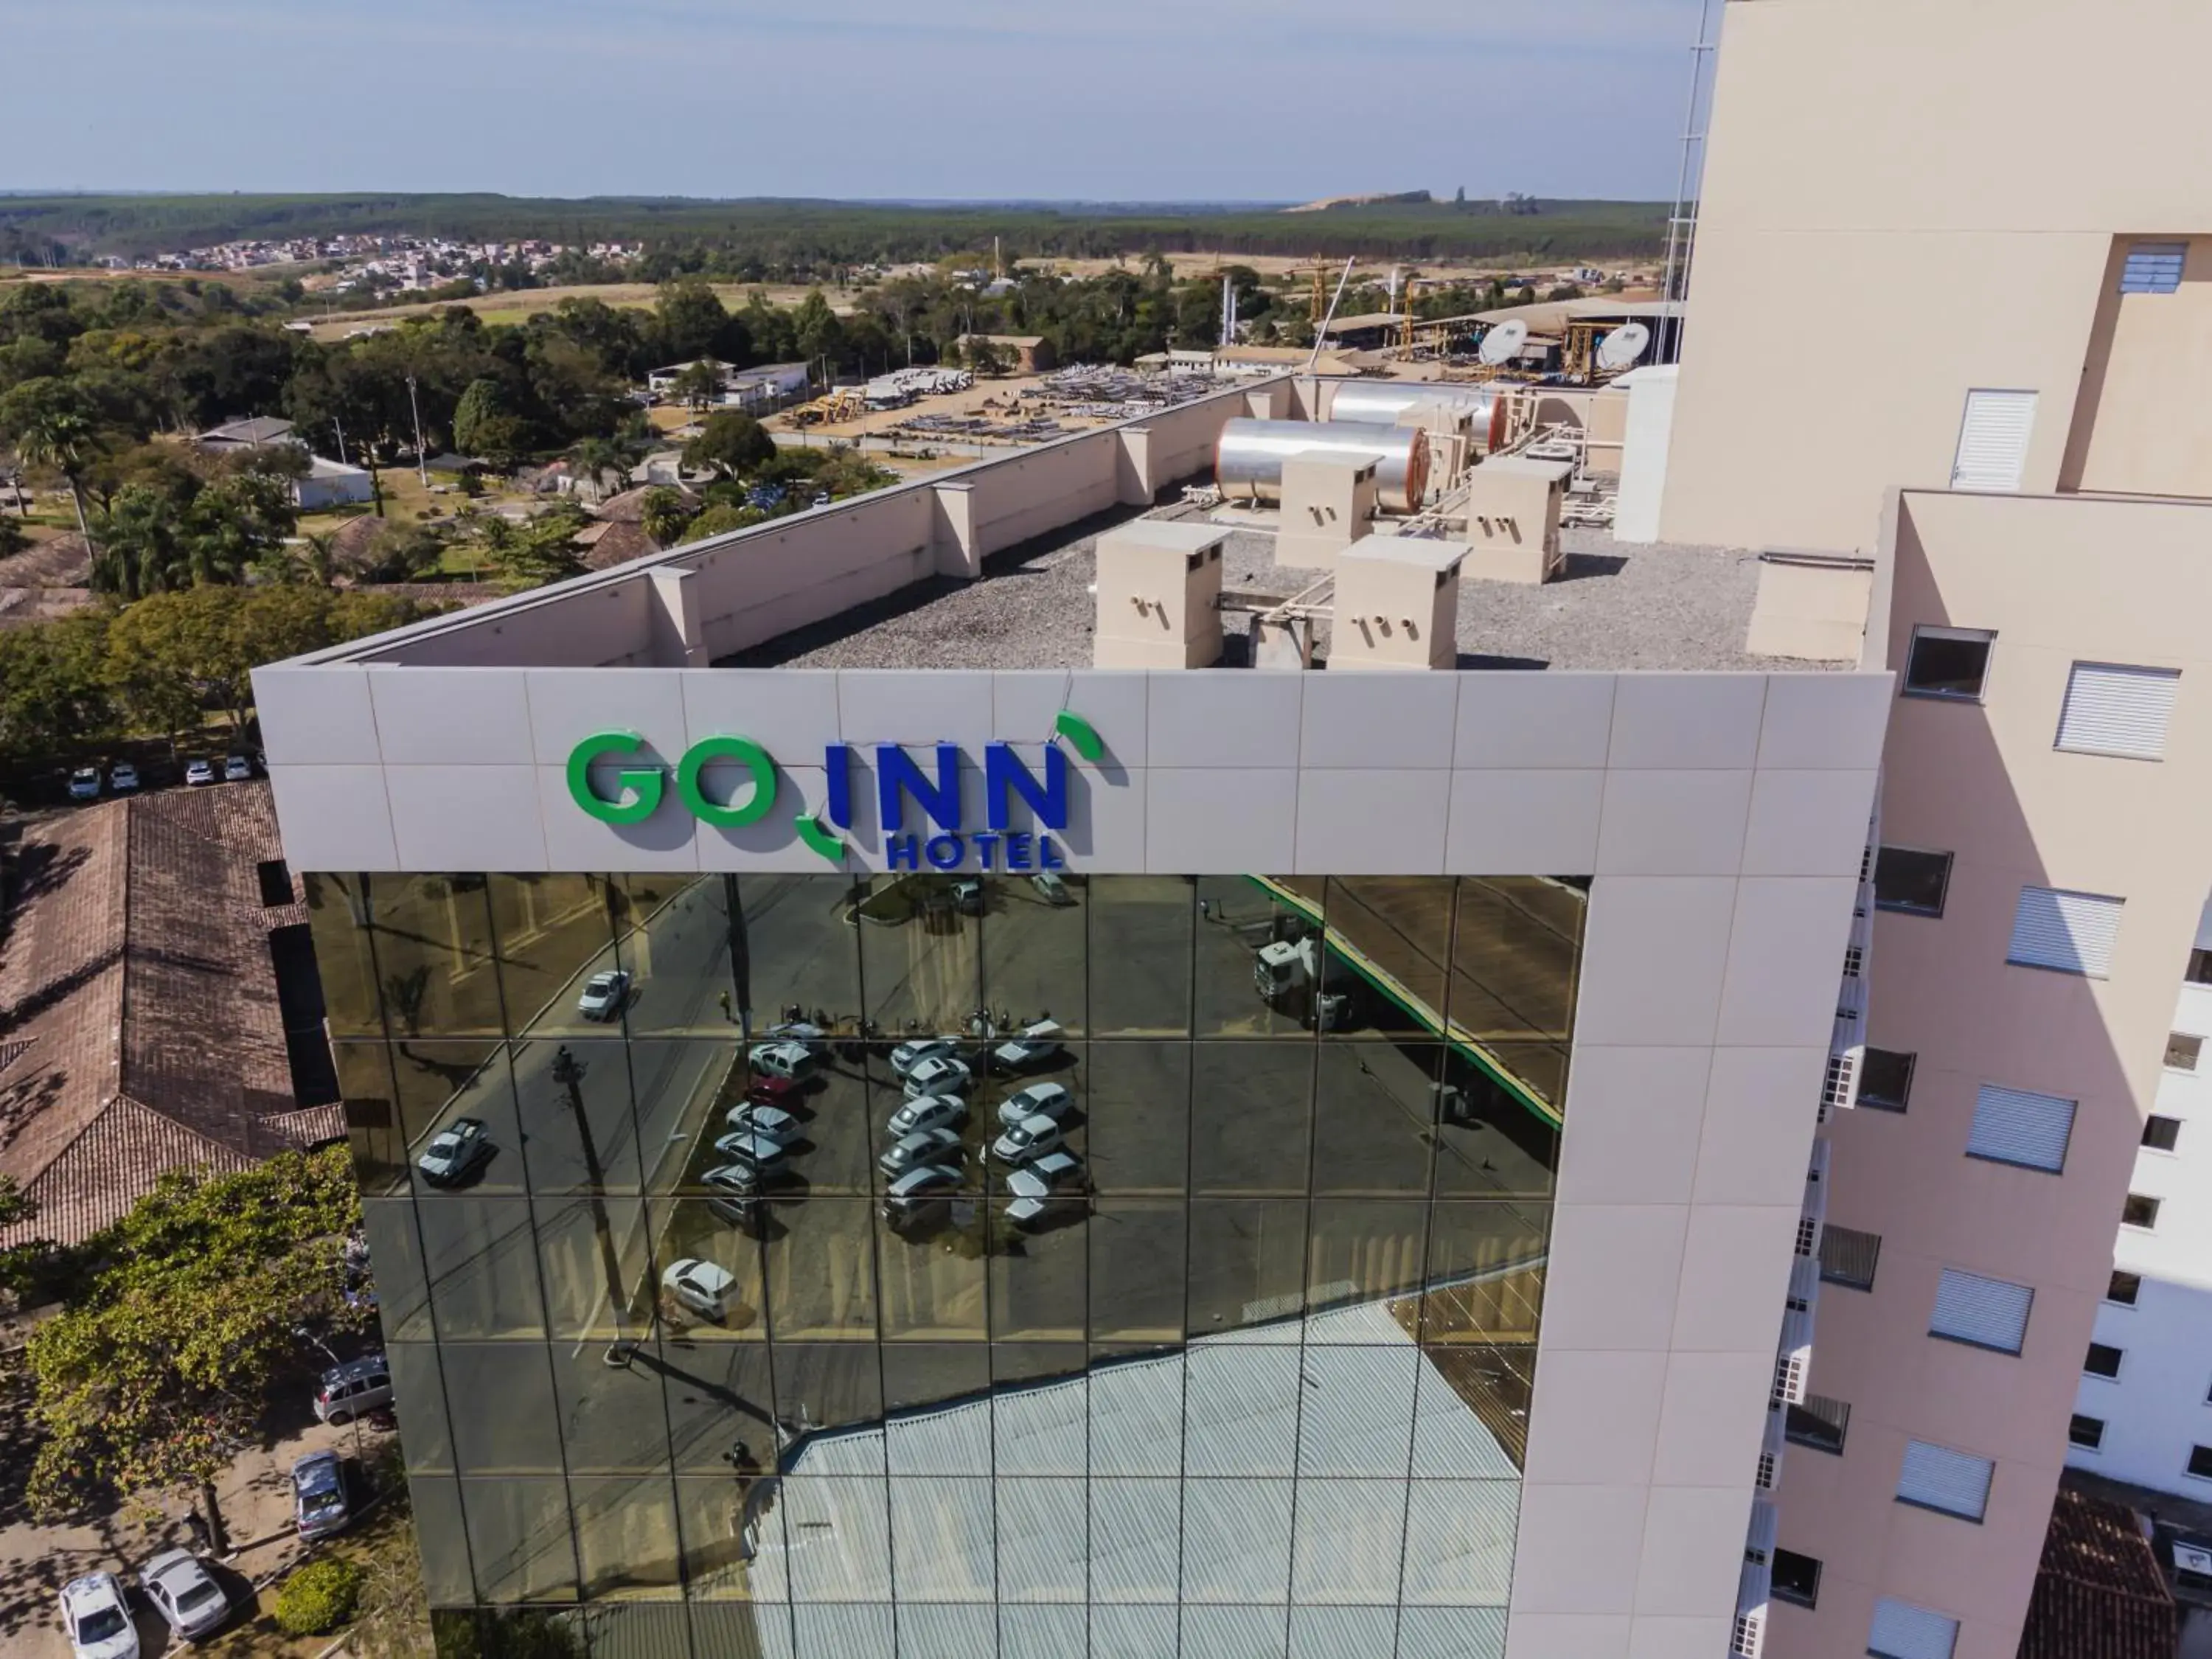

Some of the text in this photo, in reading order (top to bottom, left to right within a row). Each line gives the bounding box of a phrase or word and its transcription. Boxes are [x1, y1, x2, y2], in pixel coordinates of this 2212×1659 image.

[566, 729, 1068, 831] GO INN
[886, 833, 1063, 871] HOTEL
